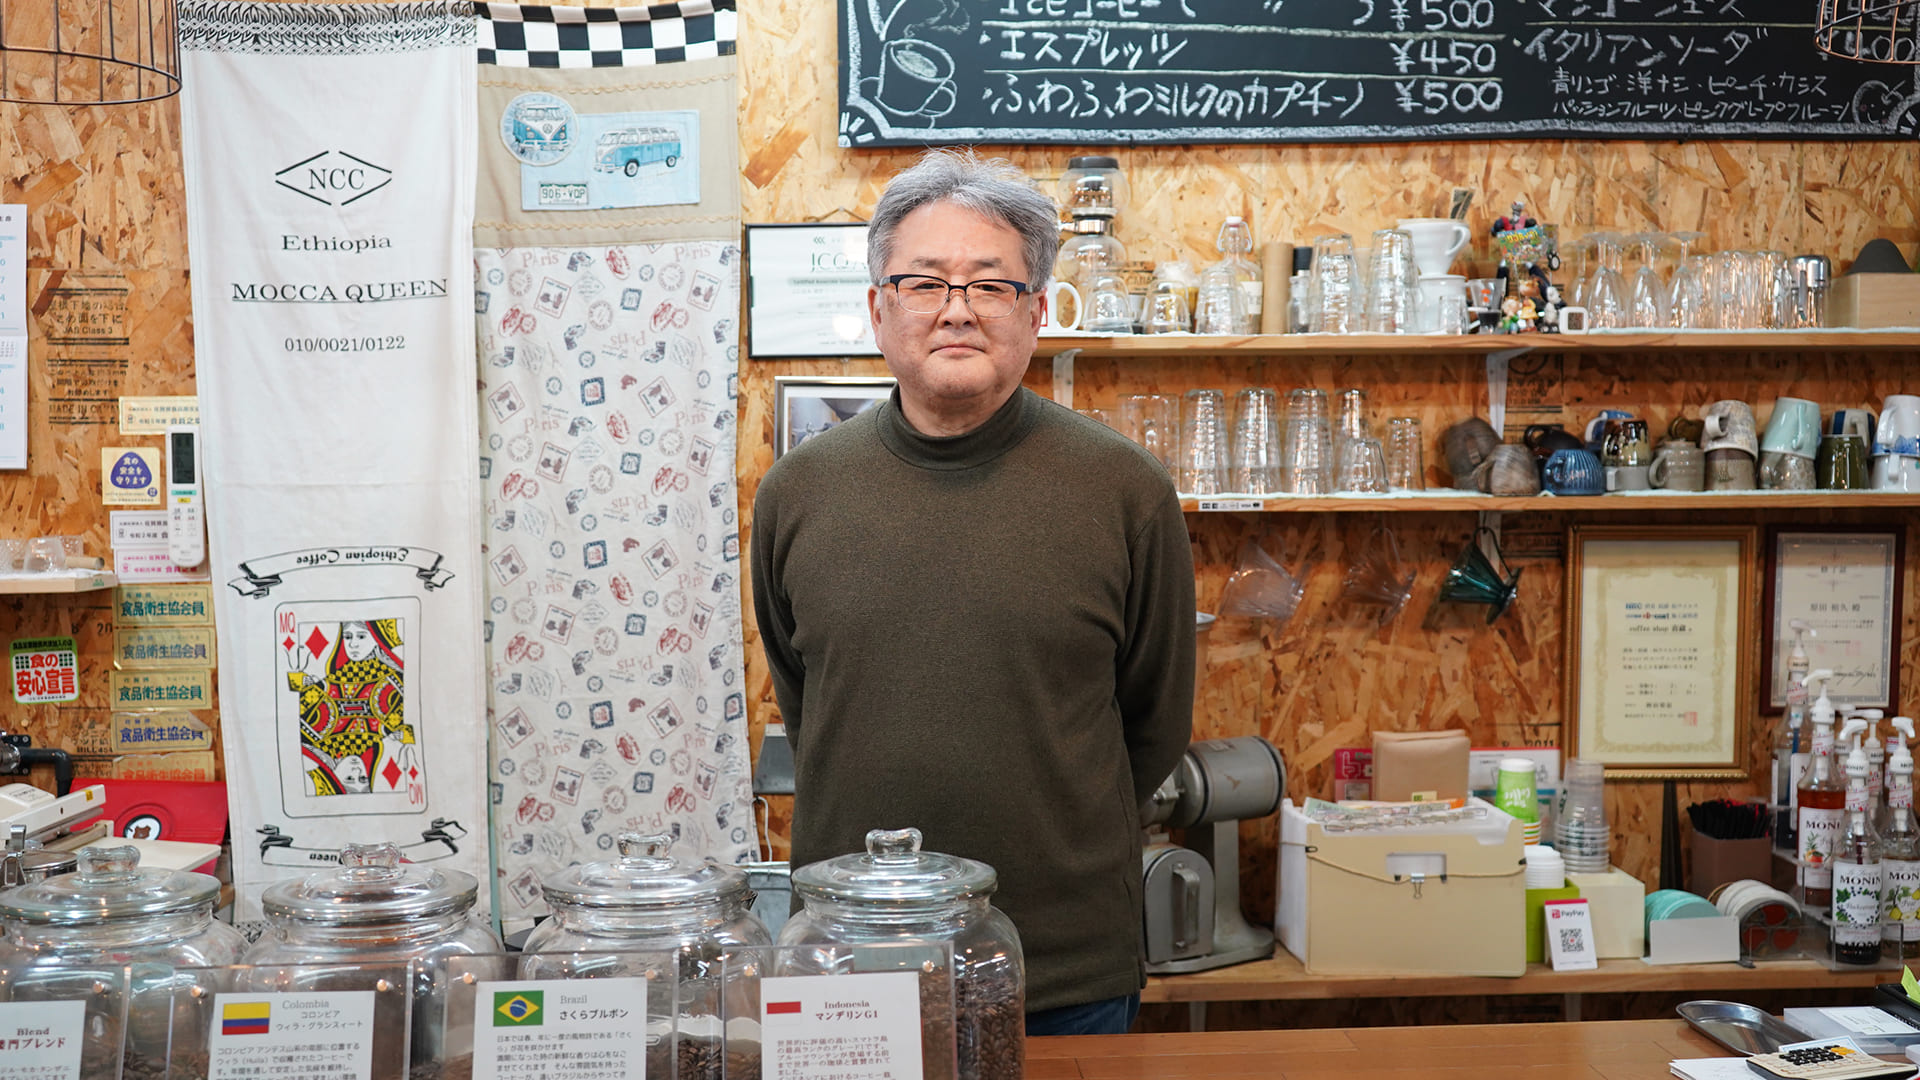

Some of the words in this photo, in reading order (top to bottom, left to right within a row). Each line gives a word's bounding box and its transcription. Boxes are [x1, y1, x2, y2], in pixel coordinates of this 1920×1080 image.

[1524, 26, 1769, 67] イタリアンソーダ
[1390, 38, 1497, 75] ¥450
[990, 72, 1364, 121] ふわふわミルクのカプチーノ
[1395, 78, 1503, 115] ¥500
[308, 168, 366, 191] NCC
[281, 234, 392, 255] Ethiopia
[232, 282, 336, 301] MOCCA
[344, 278, 448, 304] QUEEN
[284, 335, 406, 353] 010/0021/0122
[296, 550, 340, 565] Coffee
[345, 547, 409, 562] Ethiopian
[121, 601, 206, 617] 食品衛生協会員
[279, 612, 296, 633] MQ
[122, 643, 207, 660] 食品衛生協会員
[30, 653, 59, 669] 食の
[16, 667, 76, 697] 安心宣言
[118, 684, 203, 701] 食品衛生協会員
[120, 726, 204, 743] 食品衛生協会員
[1806, 820, 1840, 830] MONI
[309, 852, 343, 865] ueen
[1840, 875, 1881, 886] MONIN
[1889, 871, 1920, 881] MON
[1561, 909, 1585, 919] PayPay
[282, 1000, 330, 1009] Colombia
[560, 995, 588, 1004] Brazil
[824, 1001, 870, 1010] Indonesia
[301, 1010, 341, 1019] コロンビア
[559, 1009, 629, 1020] さくらブルボン
[815, 1010, 878, 1021] マンデリンG1
[17, 1027, 50, 1036] Blend
